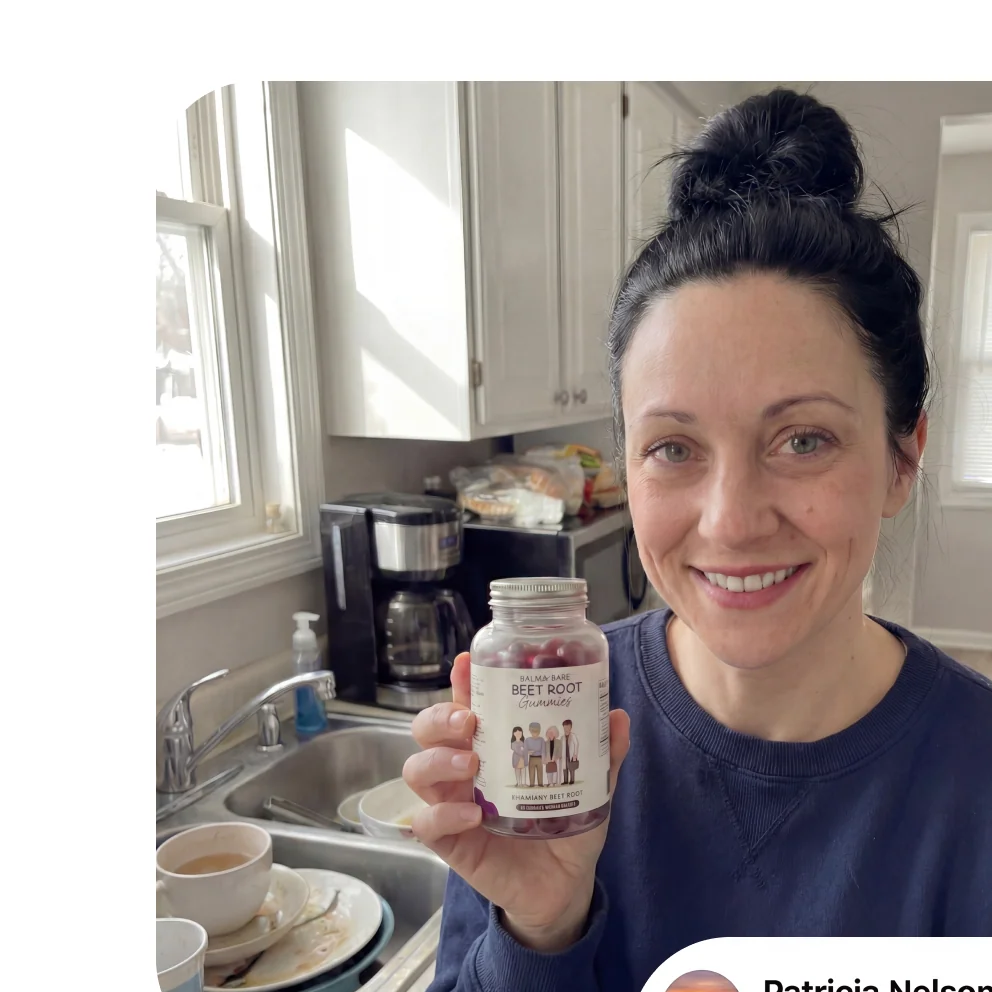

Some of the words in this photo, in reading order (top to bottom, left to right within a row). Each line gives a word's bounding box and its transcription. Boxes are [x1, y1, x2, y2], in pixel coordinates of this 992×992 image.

[551, 673, 571, 681] BARE
[511, 684, 543, 696] BEET
[547, 681, 583, 695] ROOT
[518, 694, 572, 710] Gummies
[549, 792, 565, 801] BEET
[566, 789, 583, 798] ROOT
